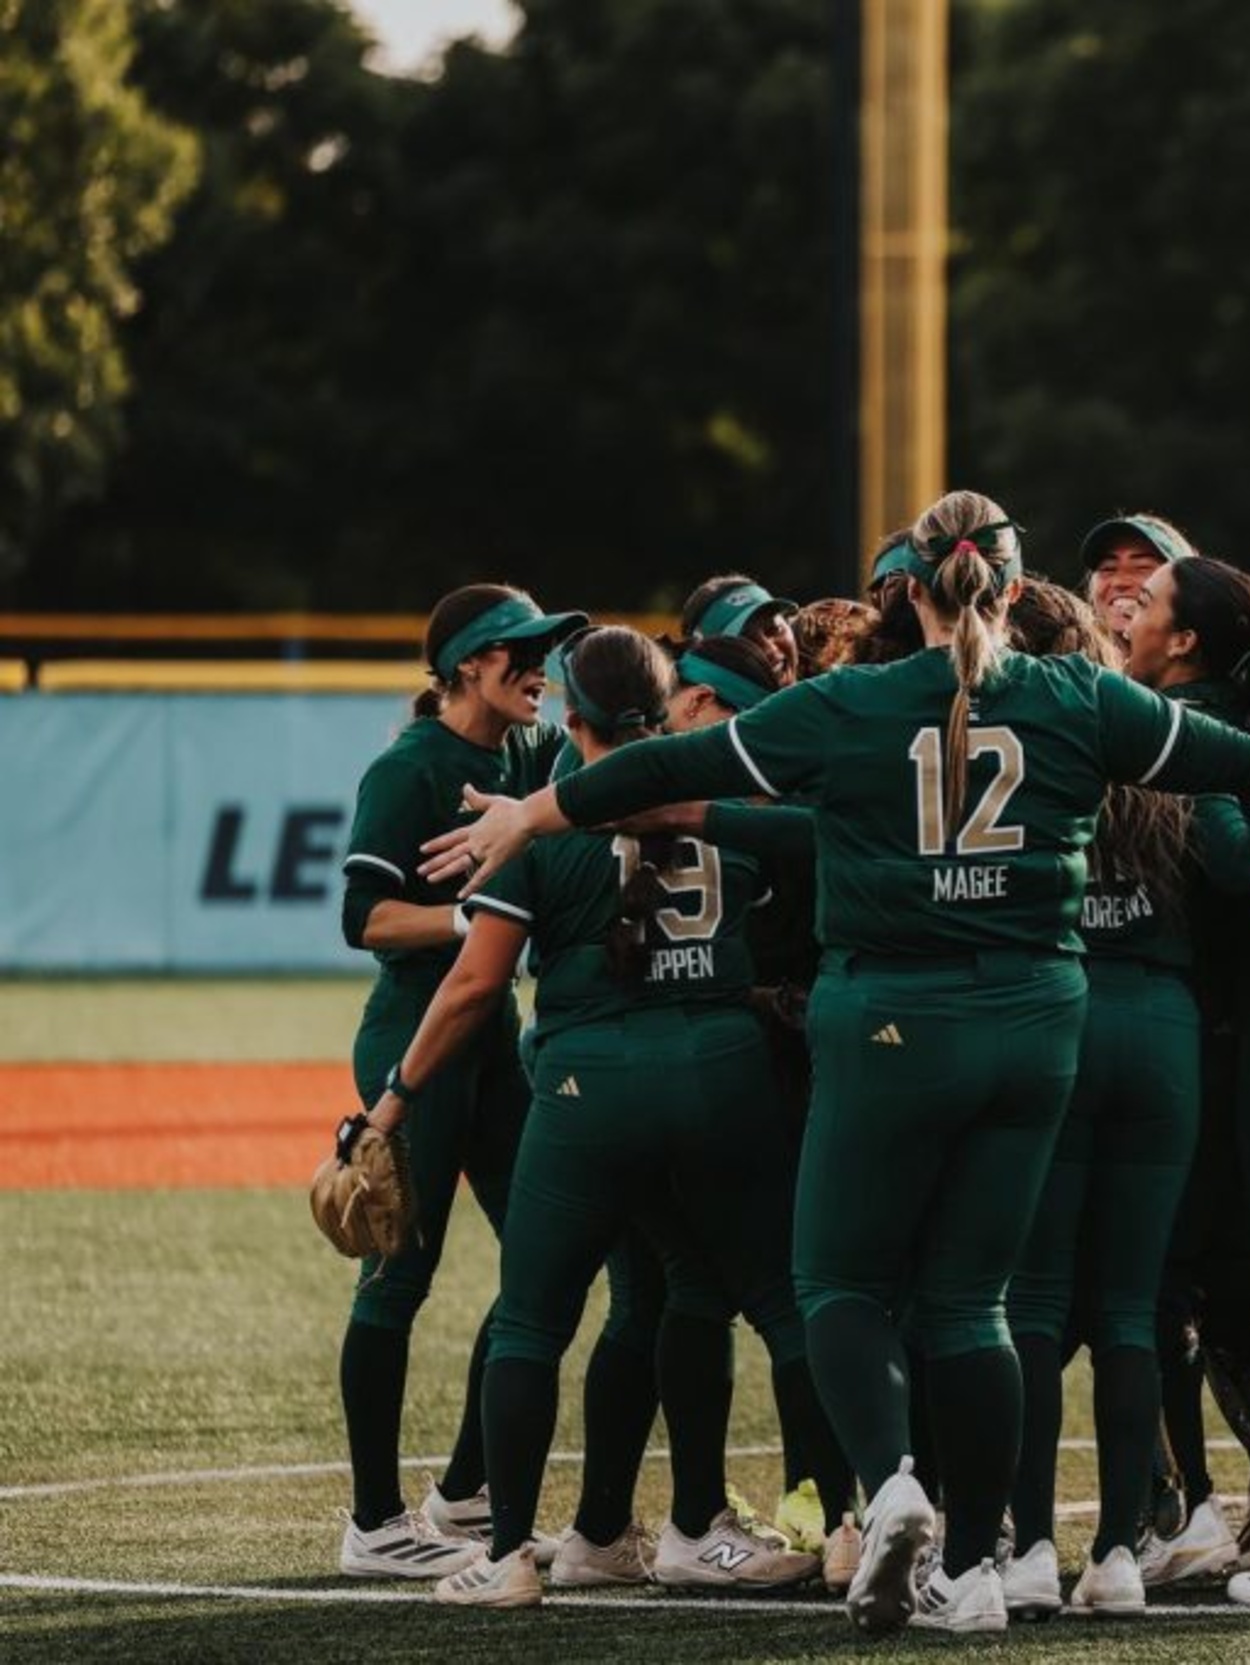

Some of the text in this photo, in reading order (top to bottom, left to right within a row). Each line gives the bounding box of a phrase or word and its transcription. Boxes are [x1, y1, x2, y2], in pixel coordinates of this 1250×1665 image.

[908, 727, 1024, 856] 12
[933, 866, 1009, 901] MAGEE
[644, 944, 715, 982] IPPEN
